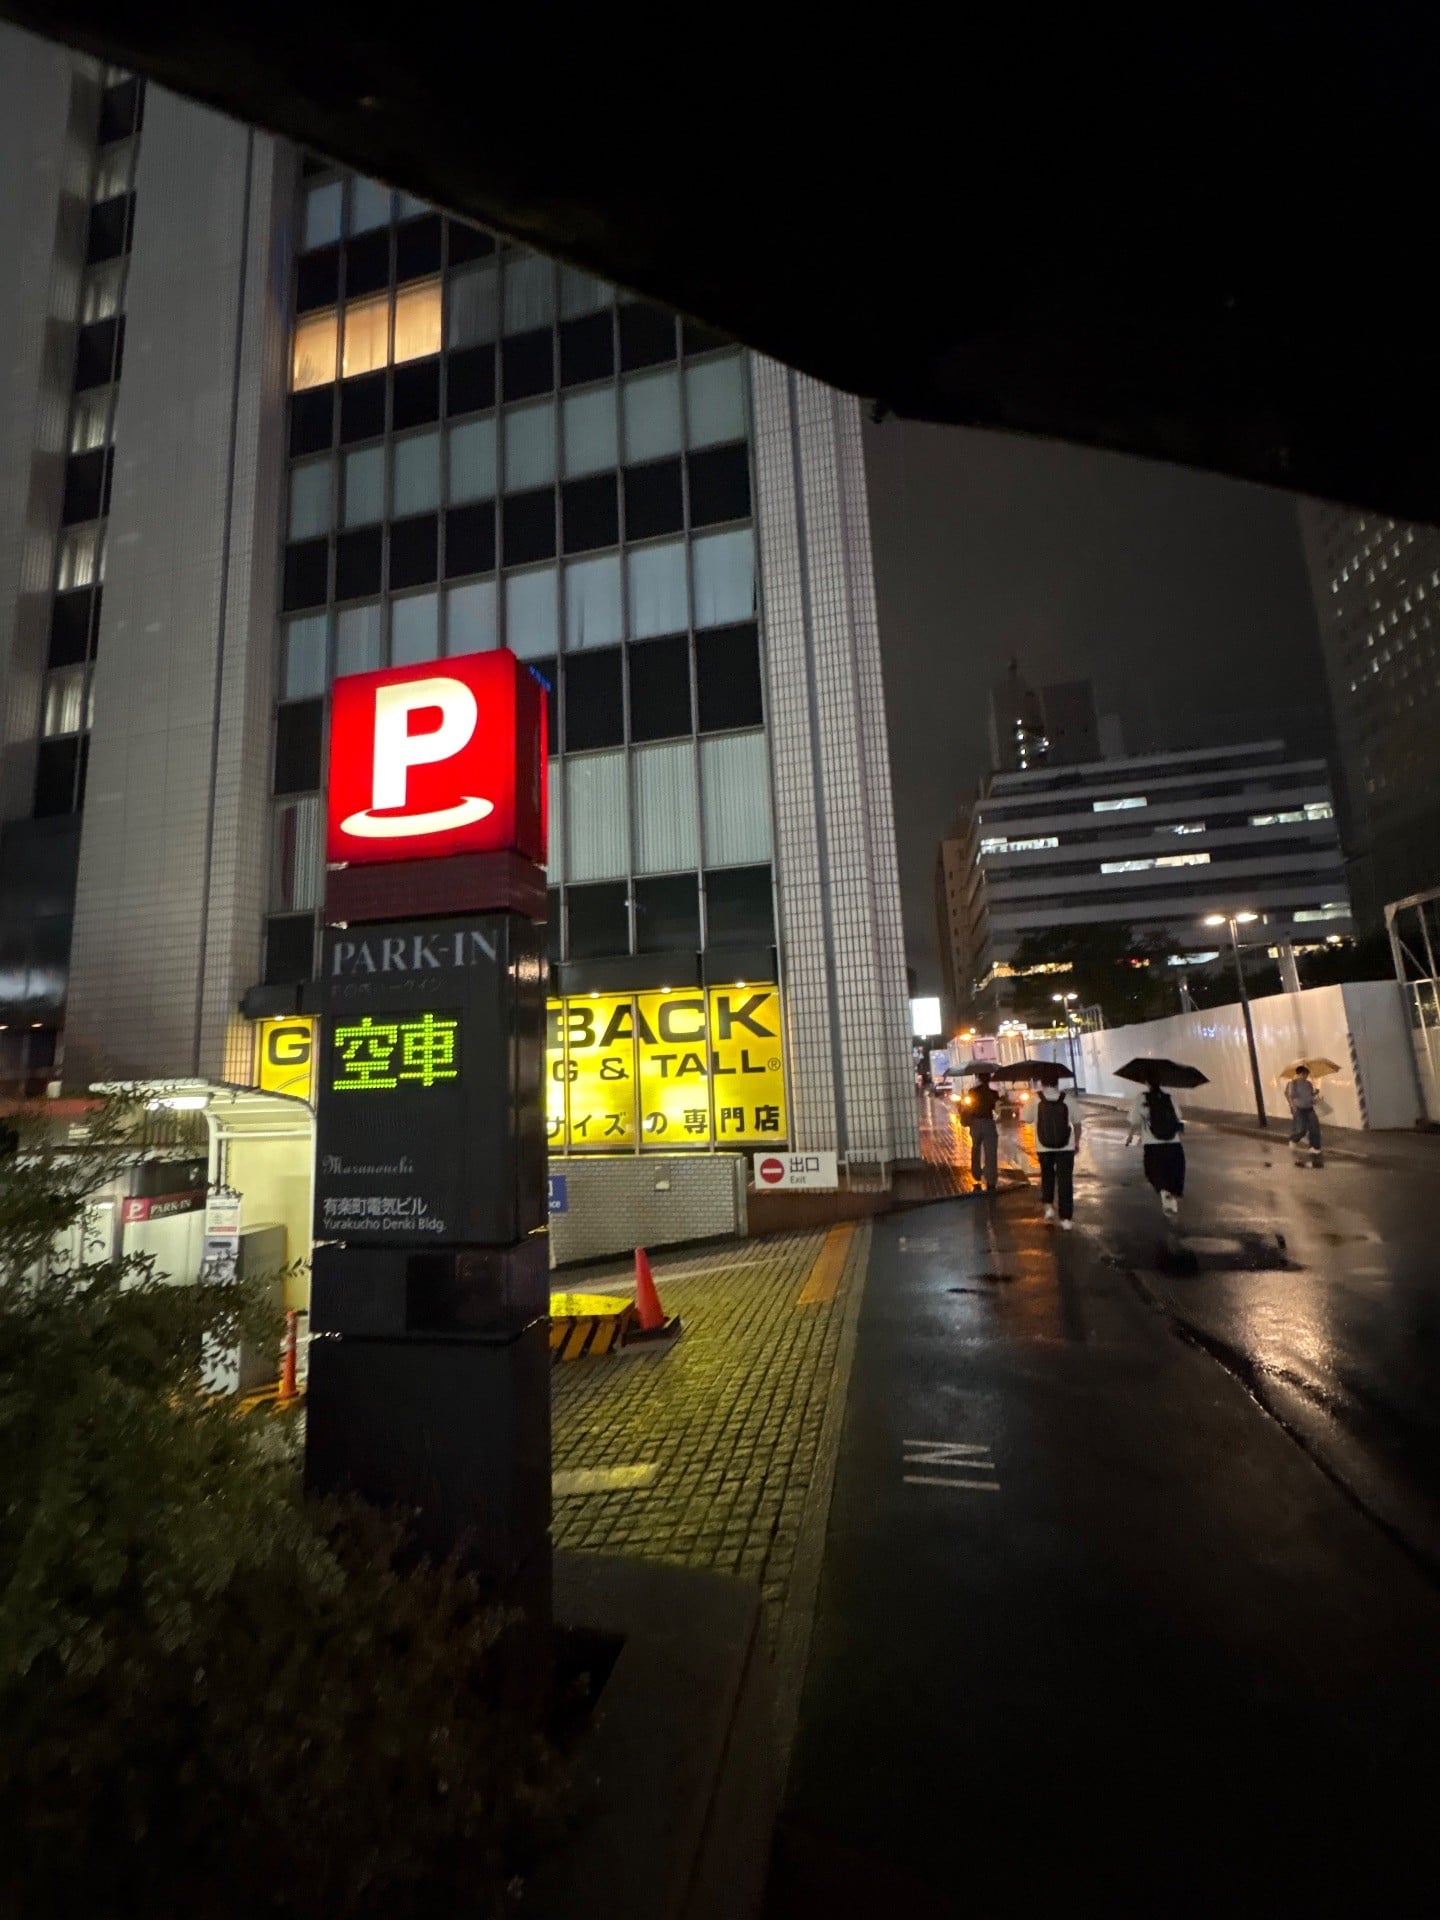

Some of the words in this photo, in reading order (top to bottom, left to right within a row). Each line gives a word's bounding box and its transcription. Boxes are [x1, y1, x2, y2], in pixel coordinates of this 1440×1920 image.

[372, 677, 478, 810] P
[332, 929, 498, 976] PARK-IN
[546, 993, 776, 1050] BACK
[333, 1013, 458, 1090] 空車
[600, 1057, 629, 1081] &
[790, 1157, 819, 1173] 出口
[790, 1176, 806, 1184] Exit
[323, 1219, 380, 1230] Yurakucho
[382, 1218, 415, 1230] Denki
